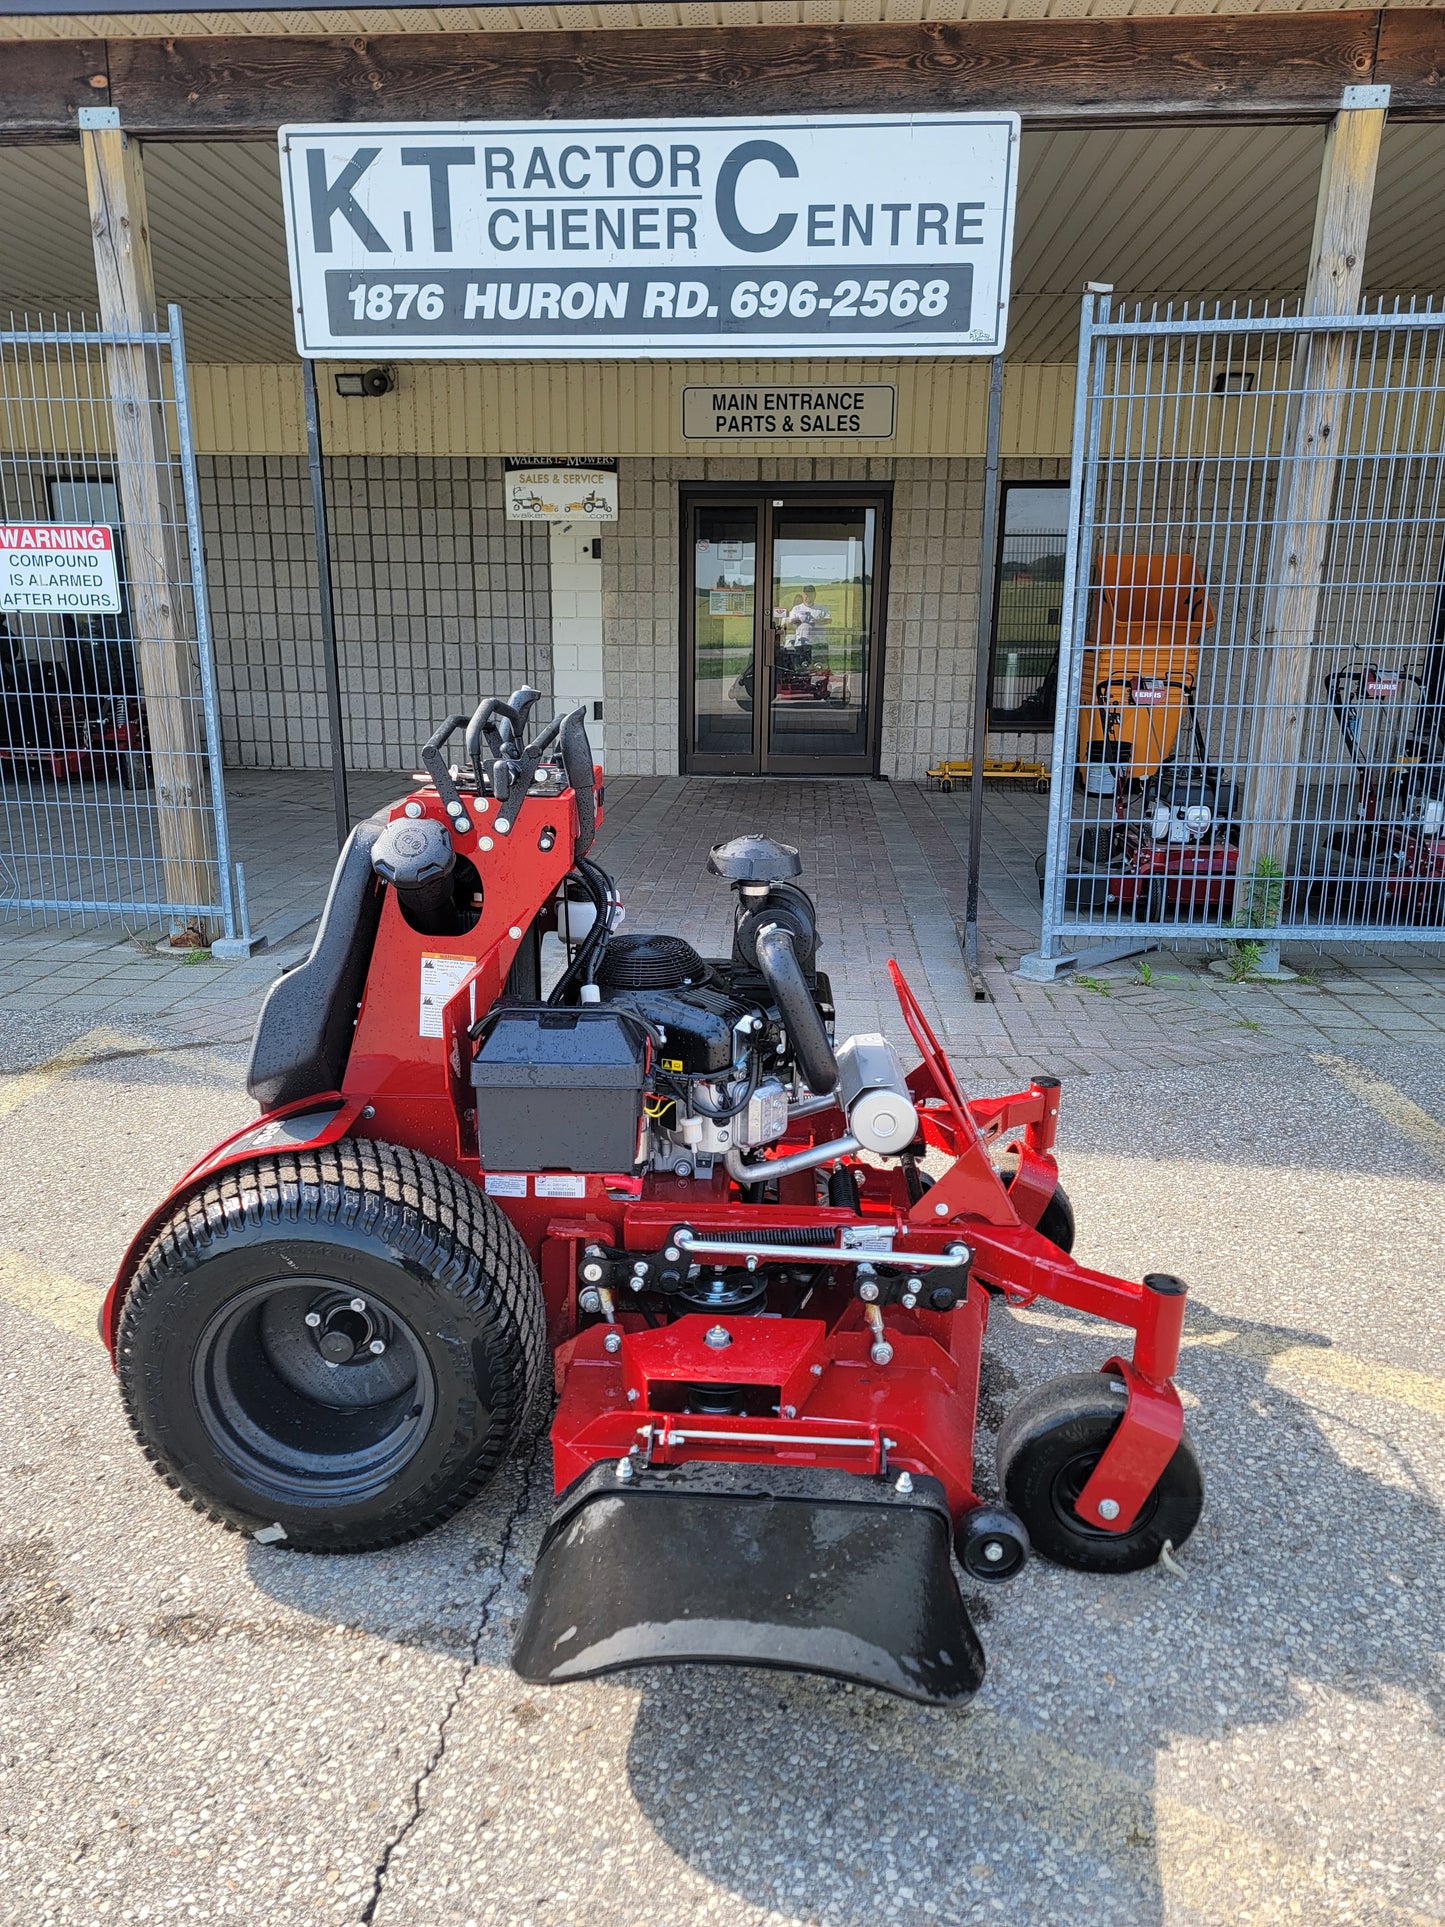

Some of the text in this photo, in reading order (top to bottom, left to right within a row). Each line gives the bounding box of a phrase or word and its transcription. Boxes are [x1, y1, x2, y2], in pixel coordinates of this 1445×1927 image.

[486, 207, 698, 252] CHENER
[348, 279, 950, 321] 1876 HURON RD. 696-2568
[712, 392, 865, 411] MAIN ENTRANCE
[716, 414, 861, 433] PARTS & SALES
[520, 474, 604, 484] SALES & SERVICE
[0, 528, 105, 549] WARNING
[9, 554, 99, 568] COMPOUND
[9, 573, 103, 588] IS ALARMED
[3, 592, 116, 607] AFTER HOURS.
